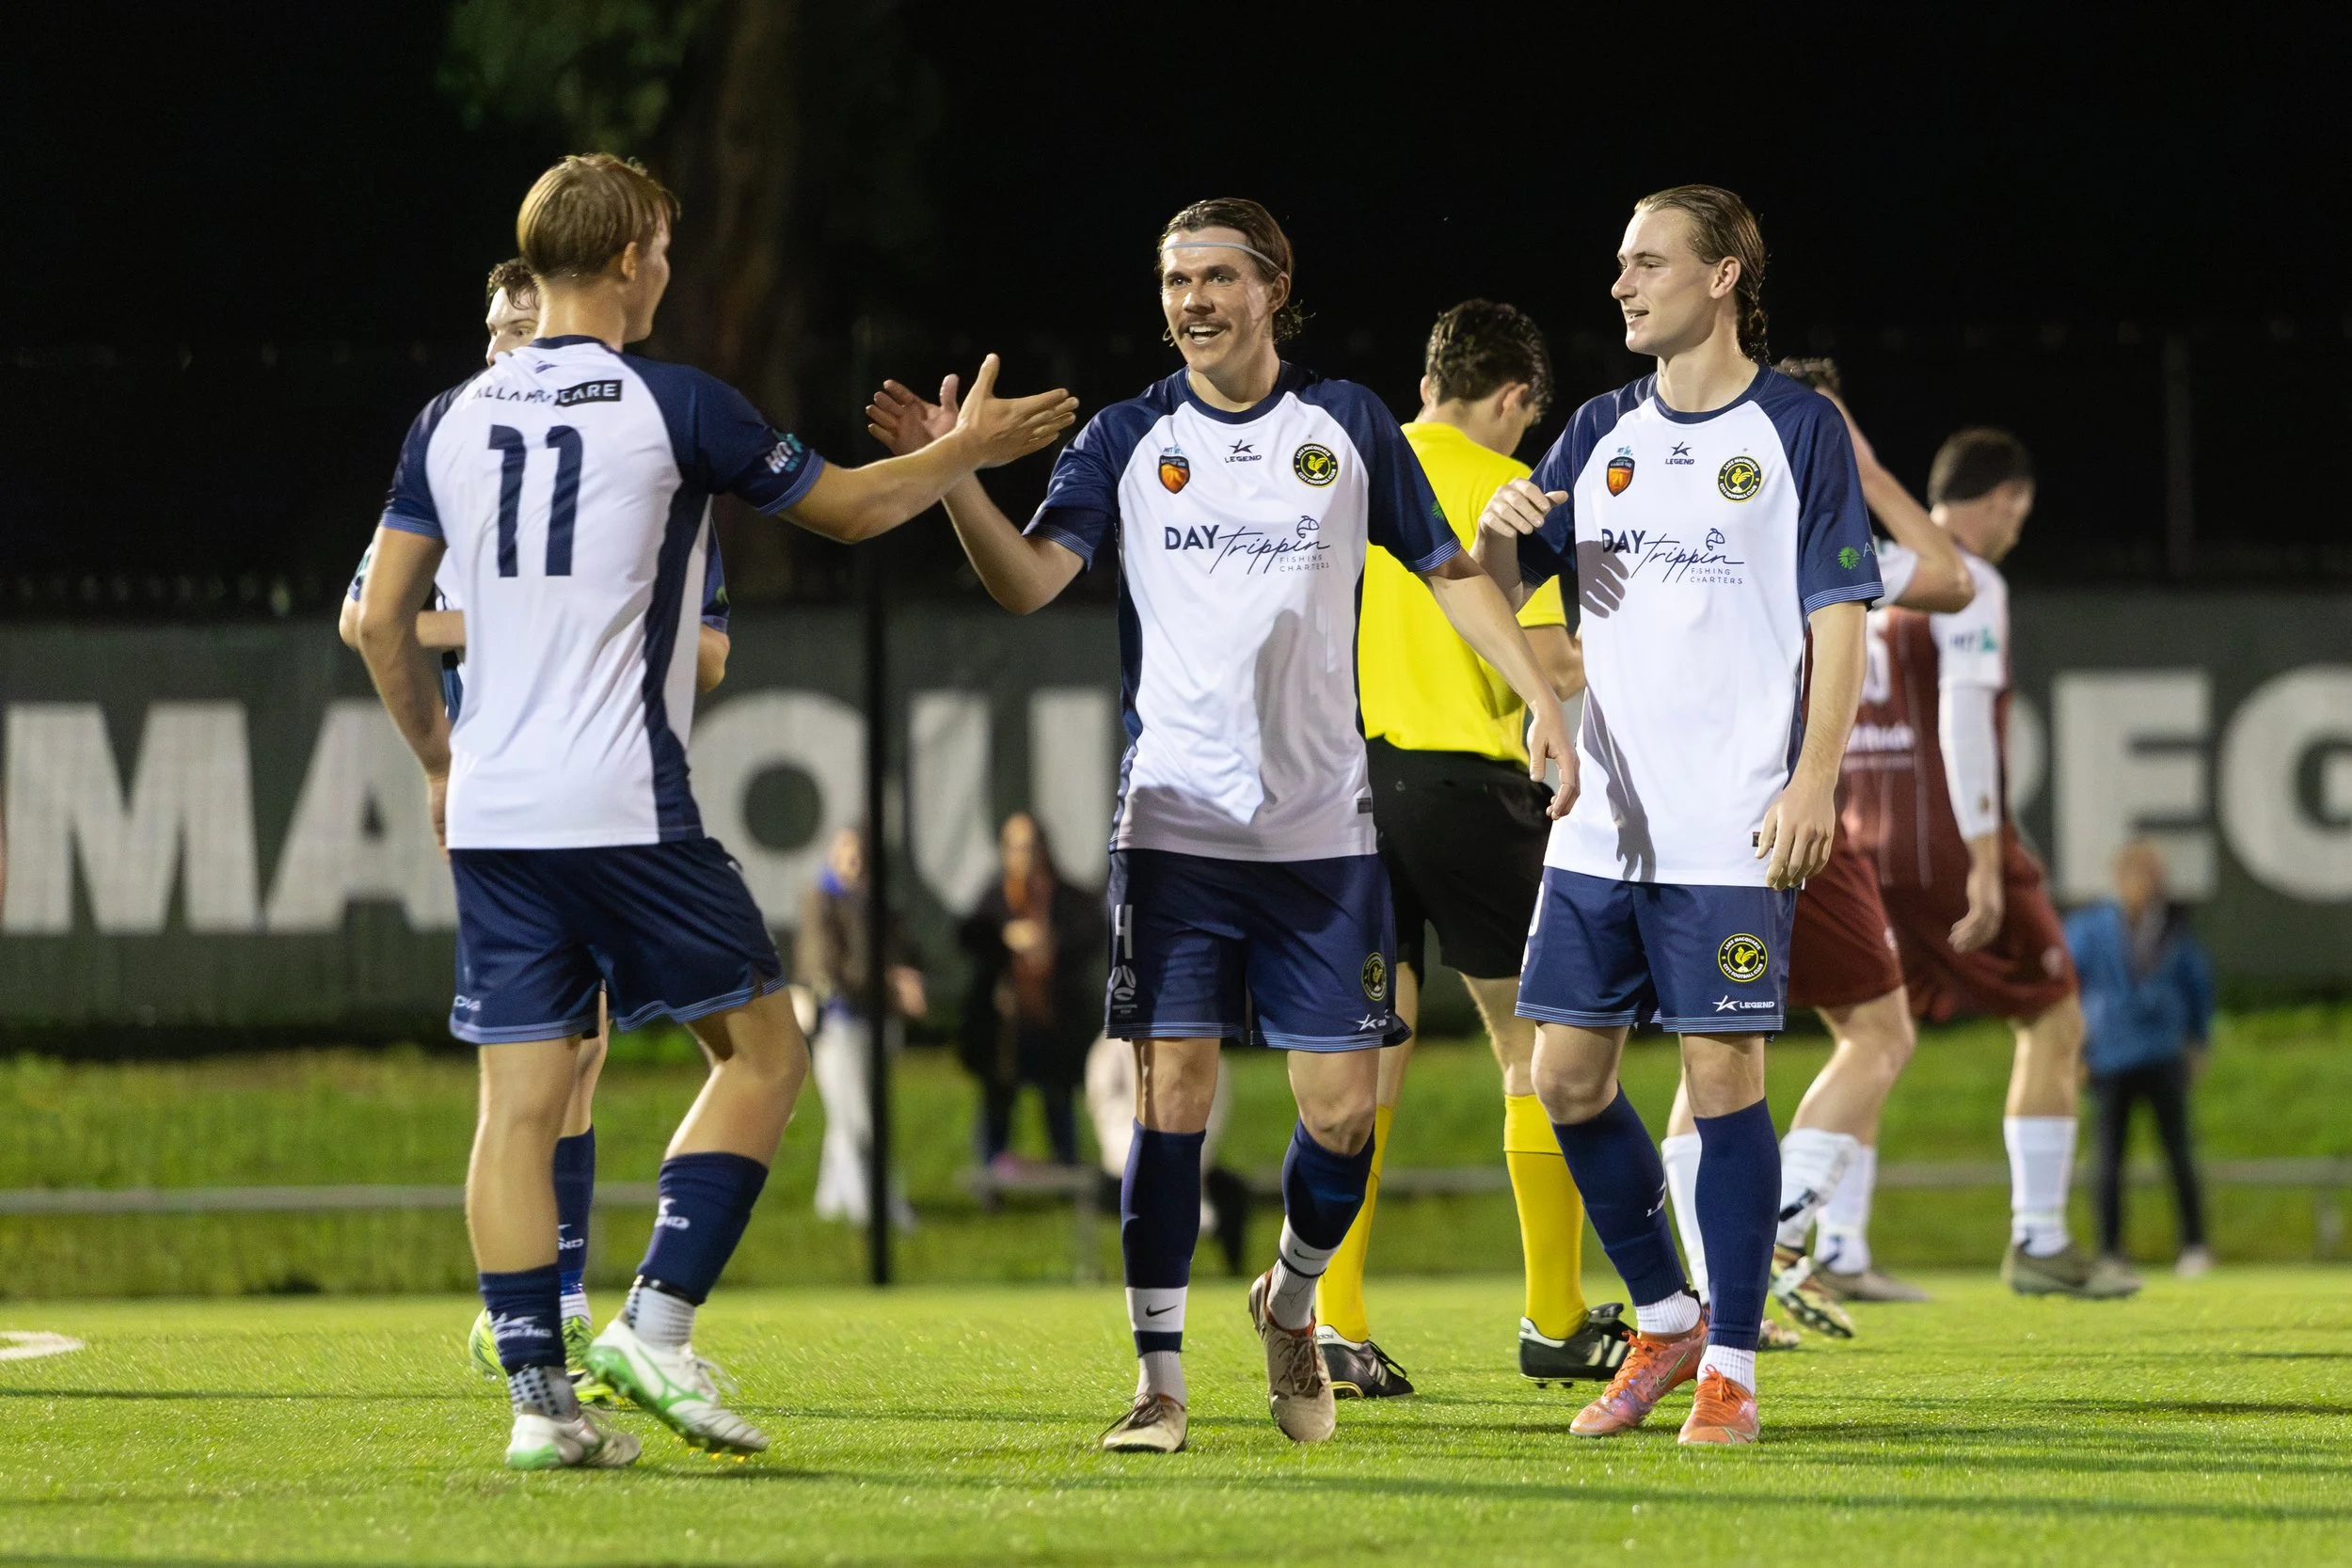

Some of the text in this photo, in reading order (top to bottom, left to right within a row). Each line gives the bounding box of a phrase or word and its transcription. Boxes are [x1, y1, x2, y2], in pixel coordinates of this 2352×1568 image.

[559, 383, 618, 404] CARE
[1224, 454, 1263, 463] LEGEND
[488, 424, 583, 578] 11
[1164, 525, 1331, 575] DAY Trippin
[1601, 529, 1744, 583] DAY Trippin
[1690, 576, 1743, 584] CHARTERS
[1692, 567, 1731, 576] FISHING
